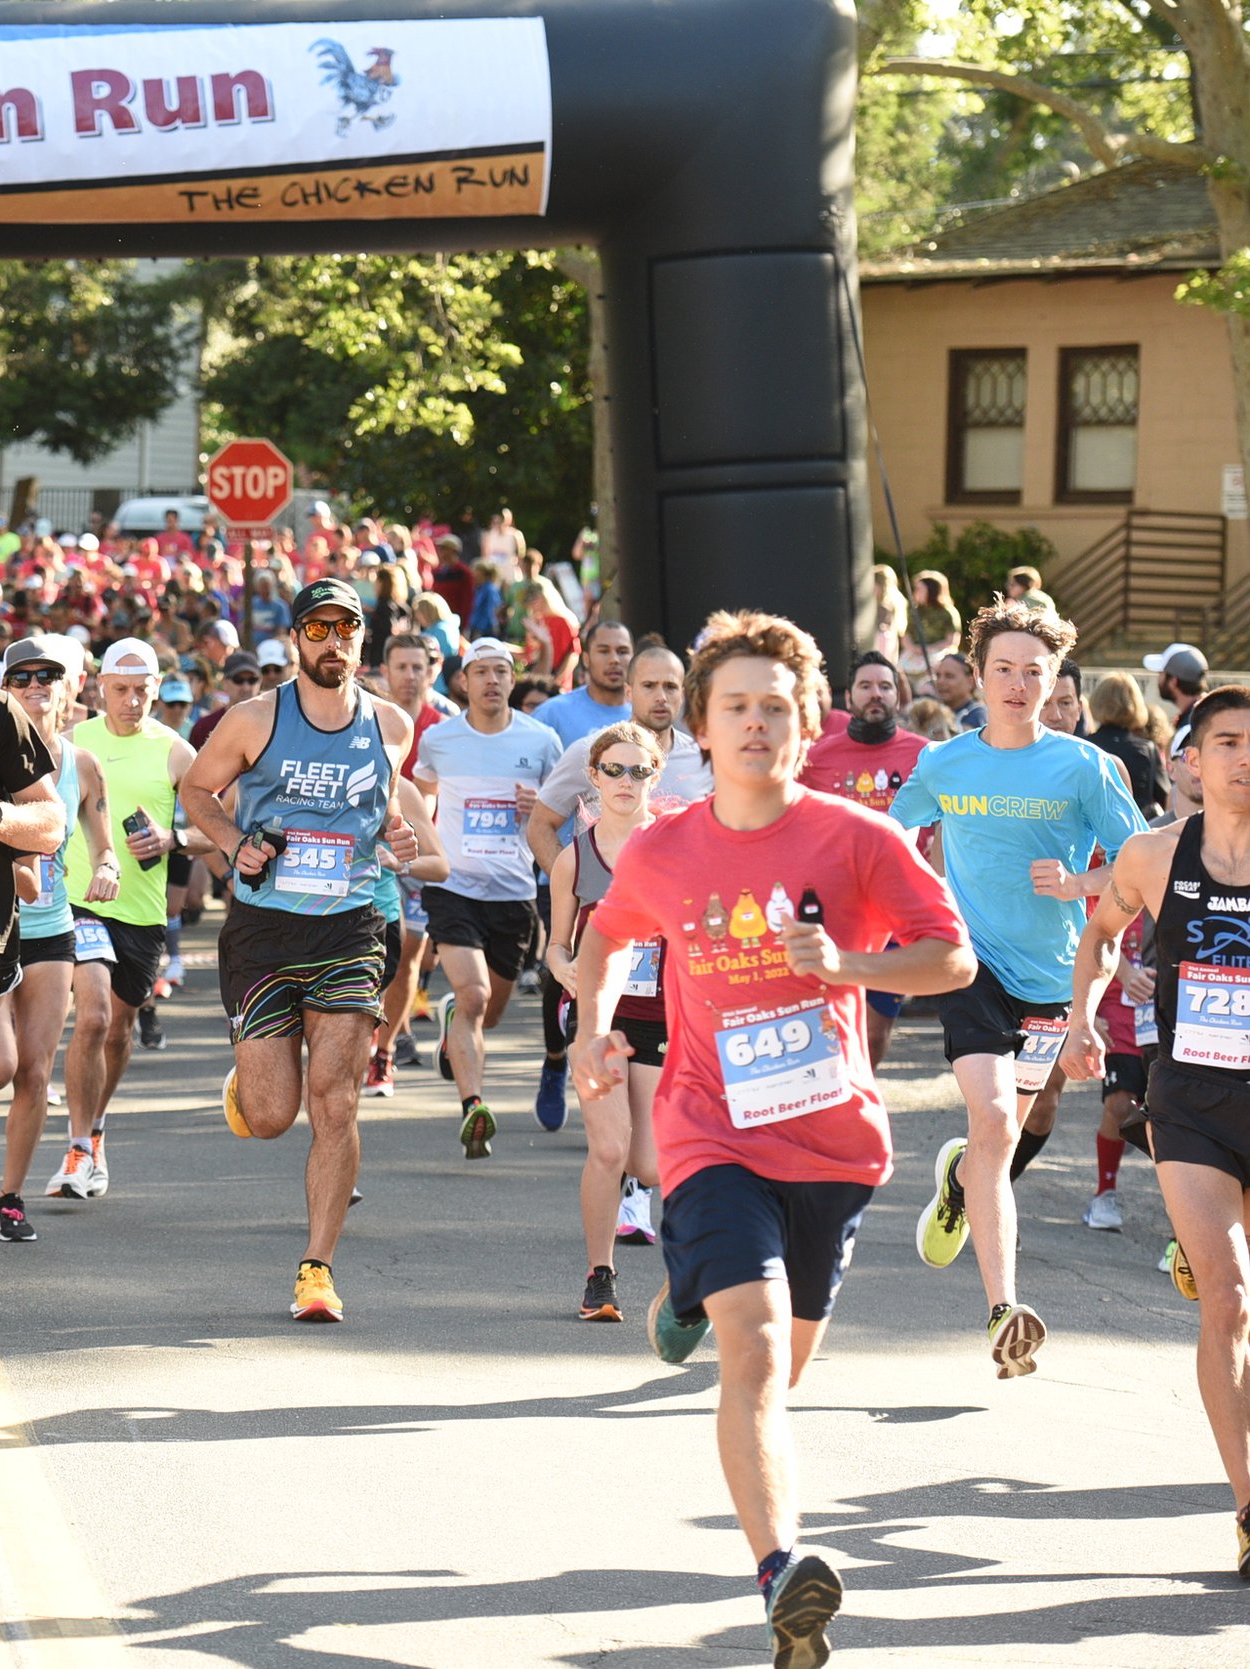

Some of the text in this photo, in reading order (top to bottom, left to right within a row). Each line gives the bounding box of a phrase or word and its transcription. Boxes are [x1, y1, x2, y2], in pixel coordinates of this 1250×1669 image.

[70, 68, 275, 137] Run
[179, 164, 531, 212] THE CHICKEN RUN
[210, 465, 287, 499] STOP
[280, 760, 350, 781] FLEET
[285, 777, 343, 799] FEET
[275, 794, 345, 810] RACING TEAM
[938, 794, 1068, 821] RUNCREW
[468, 812, 508, 829] 794
[336, 838, 351, 846] Run
[283, 847, 337, 870] 545
[716, 951, 760, 972] Oaks
[728, 974, 751, 985] May
[763, 967, 790, 979] 2022
[1187, 971, 1207, 981] Fair
[1207, 974, 1234, 983] Oaks
[722, 996, 825, 1028] Fair Oaks Sun Run
[1185, 985, 1250, 1018] 728
[1028, 1023, 1042, 1031] Fair
[1042, 1025, 1061, 1033] Oaks
[725, 1019, 813, 1068] 649
[1182, 1047, 1211, 1059] Root
[1213, 1051, 1239, 1063] Beer
[743, 1106, 775, 1120] Root
[778, 1098, 808, 1113] Beer
[810, 1087, 843, 1105] Float
